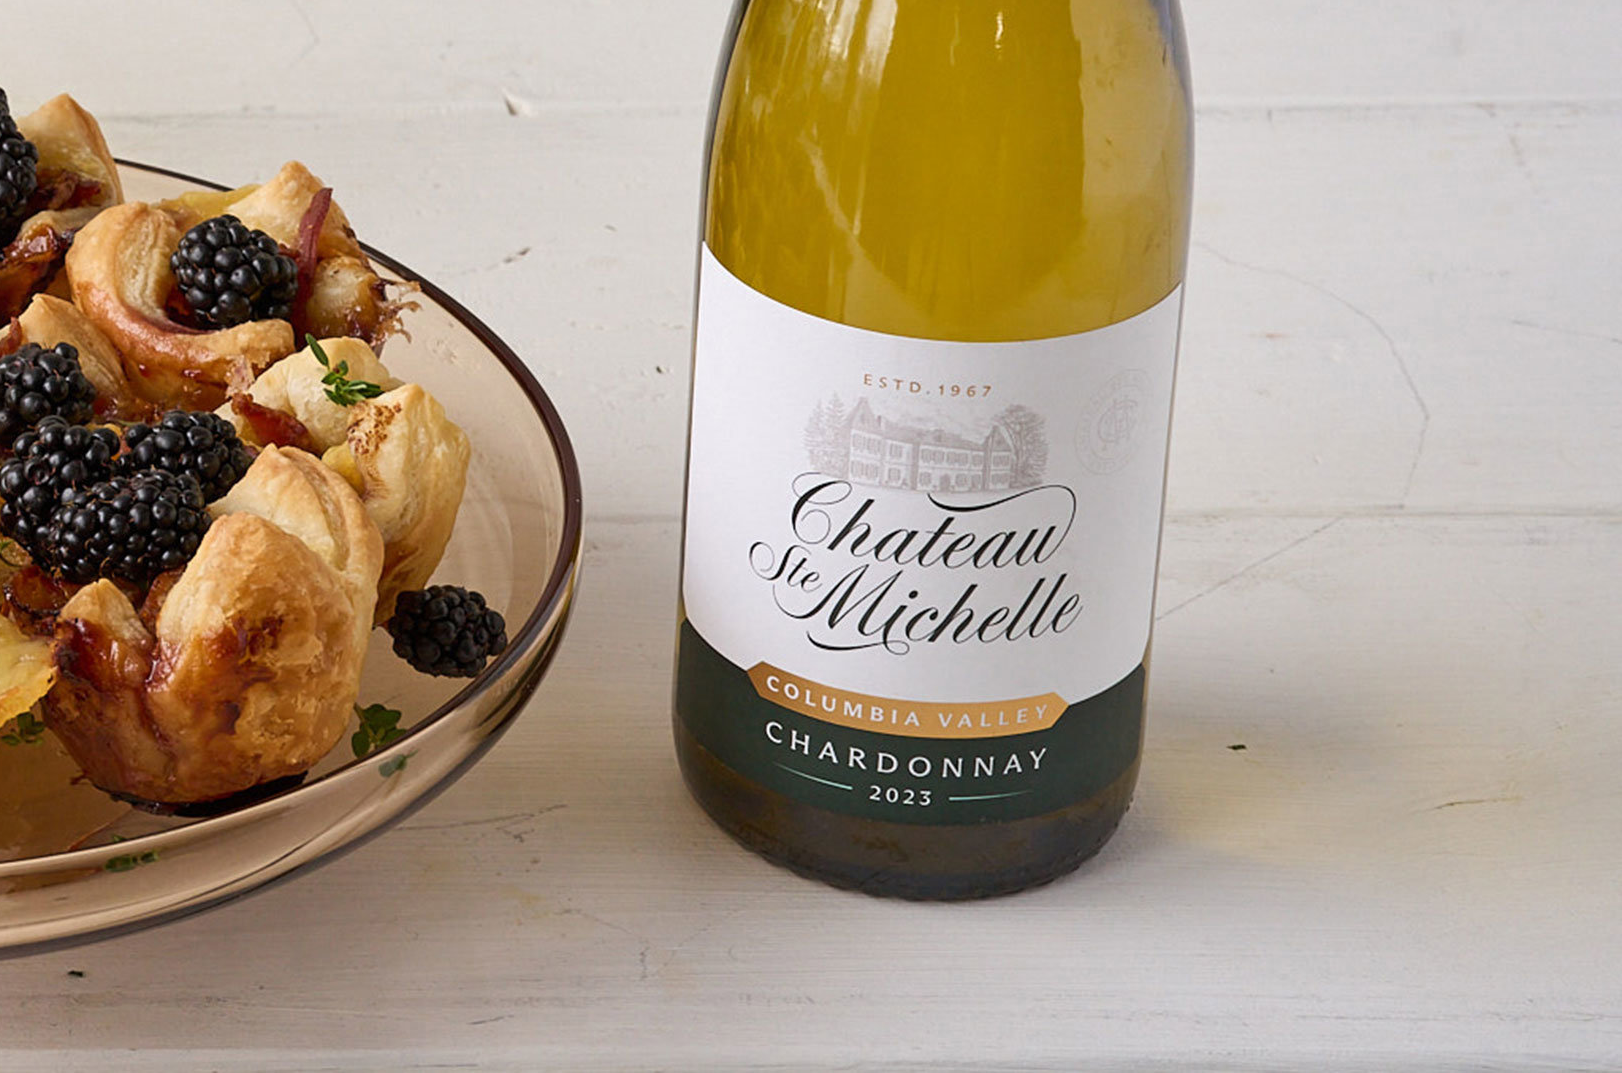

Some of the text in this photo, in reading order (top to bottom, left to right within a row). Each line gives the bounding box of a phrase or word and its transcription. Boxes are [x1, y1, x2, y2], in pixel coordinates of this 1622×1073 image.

[791, 472, 1077, 569] Chateau
[749, 541, 1083, 656] Ste Michelle
[765, 676, 1047, 728] COLUMBIA VALLEY
[765, 721, 1047, 778] CHARDONNAY
[868, 785, 932, 806] 2023
